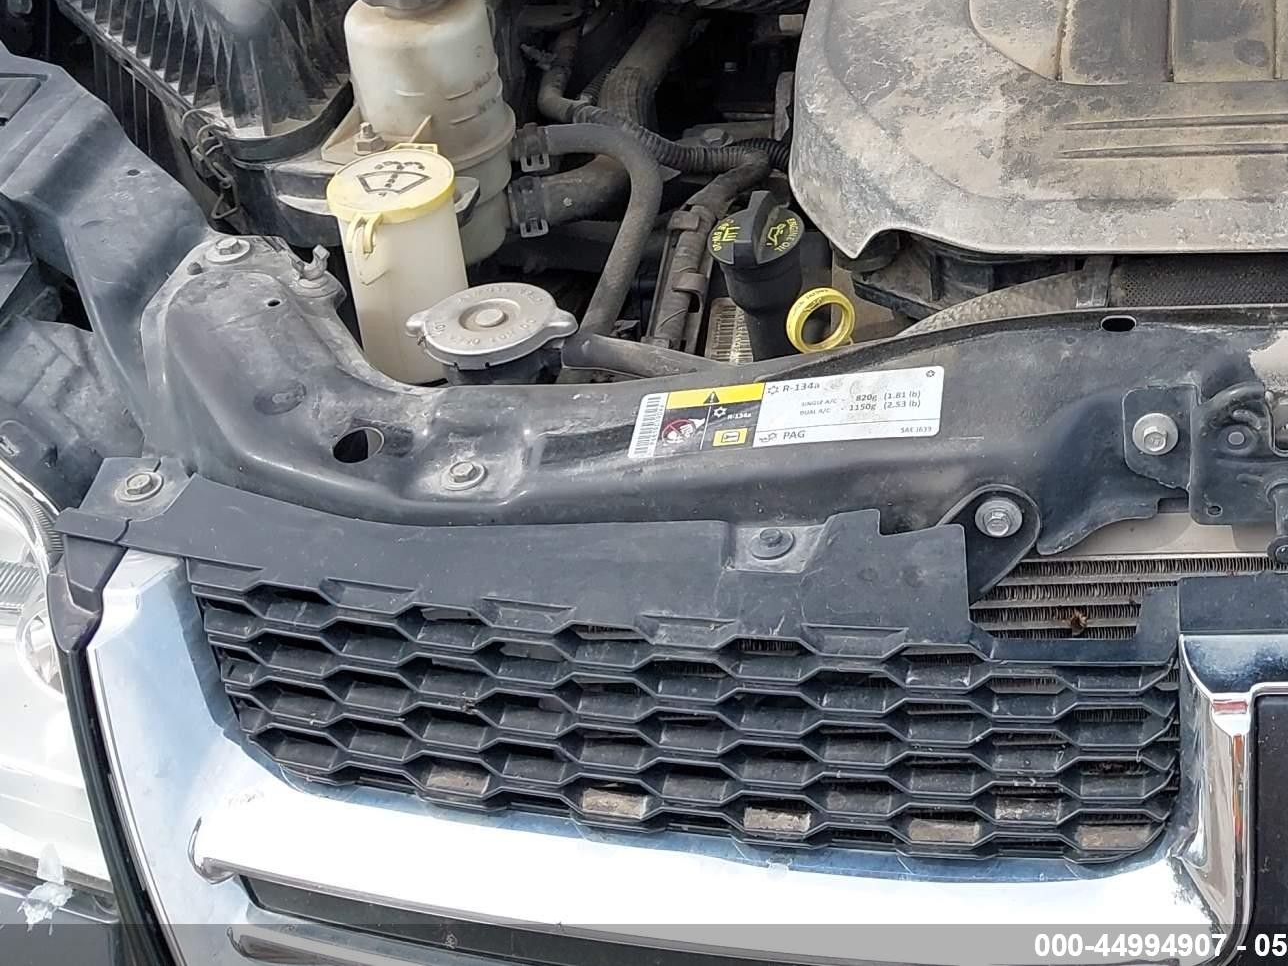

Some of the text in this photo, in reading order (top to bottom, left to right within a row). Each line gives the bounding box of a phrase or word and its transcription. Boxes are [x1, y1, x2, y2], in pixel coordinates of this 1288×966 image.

[774, 217, 799, 252] ENGINE OIL
[782, 382, 820, 392] R-134a
[825, 397, 838, 405] A/C
[855, 393, 878, 402] 820g
[884, 392, 906, 400] (1.81
[908, 390, 922, 399] lb)
[800, 408, 817, 416] DUAL
[818, 407, 831, 415] A/C
[850, 403, 876, 412] 1150g
[884, 401, 907, 410] (2.53
[908, 400, 922, 409] lb)
[782, 431, 806, 440] PAG
